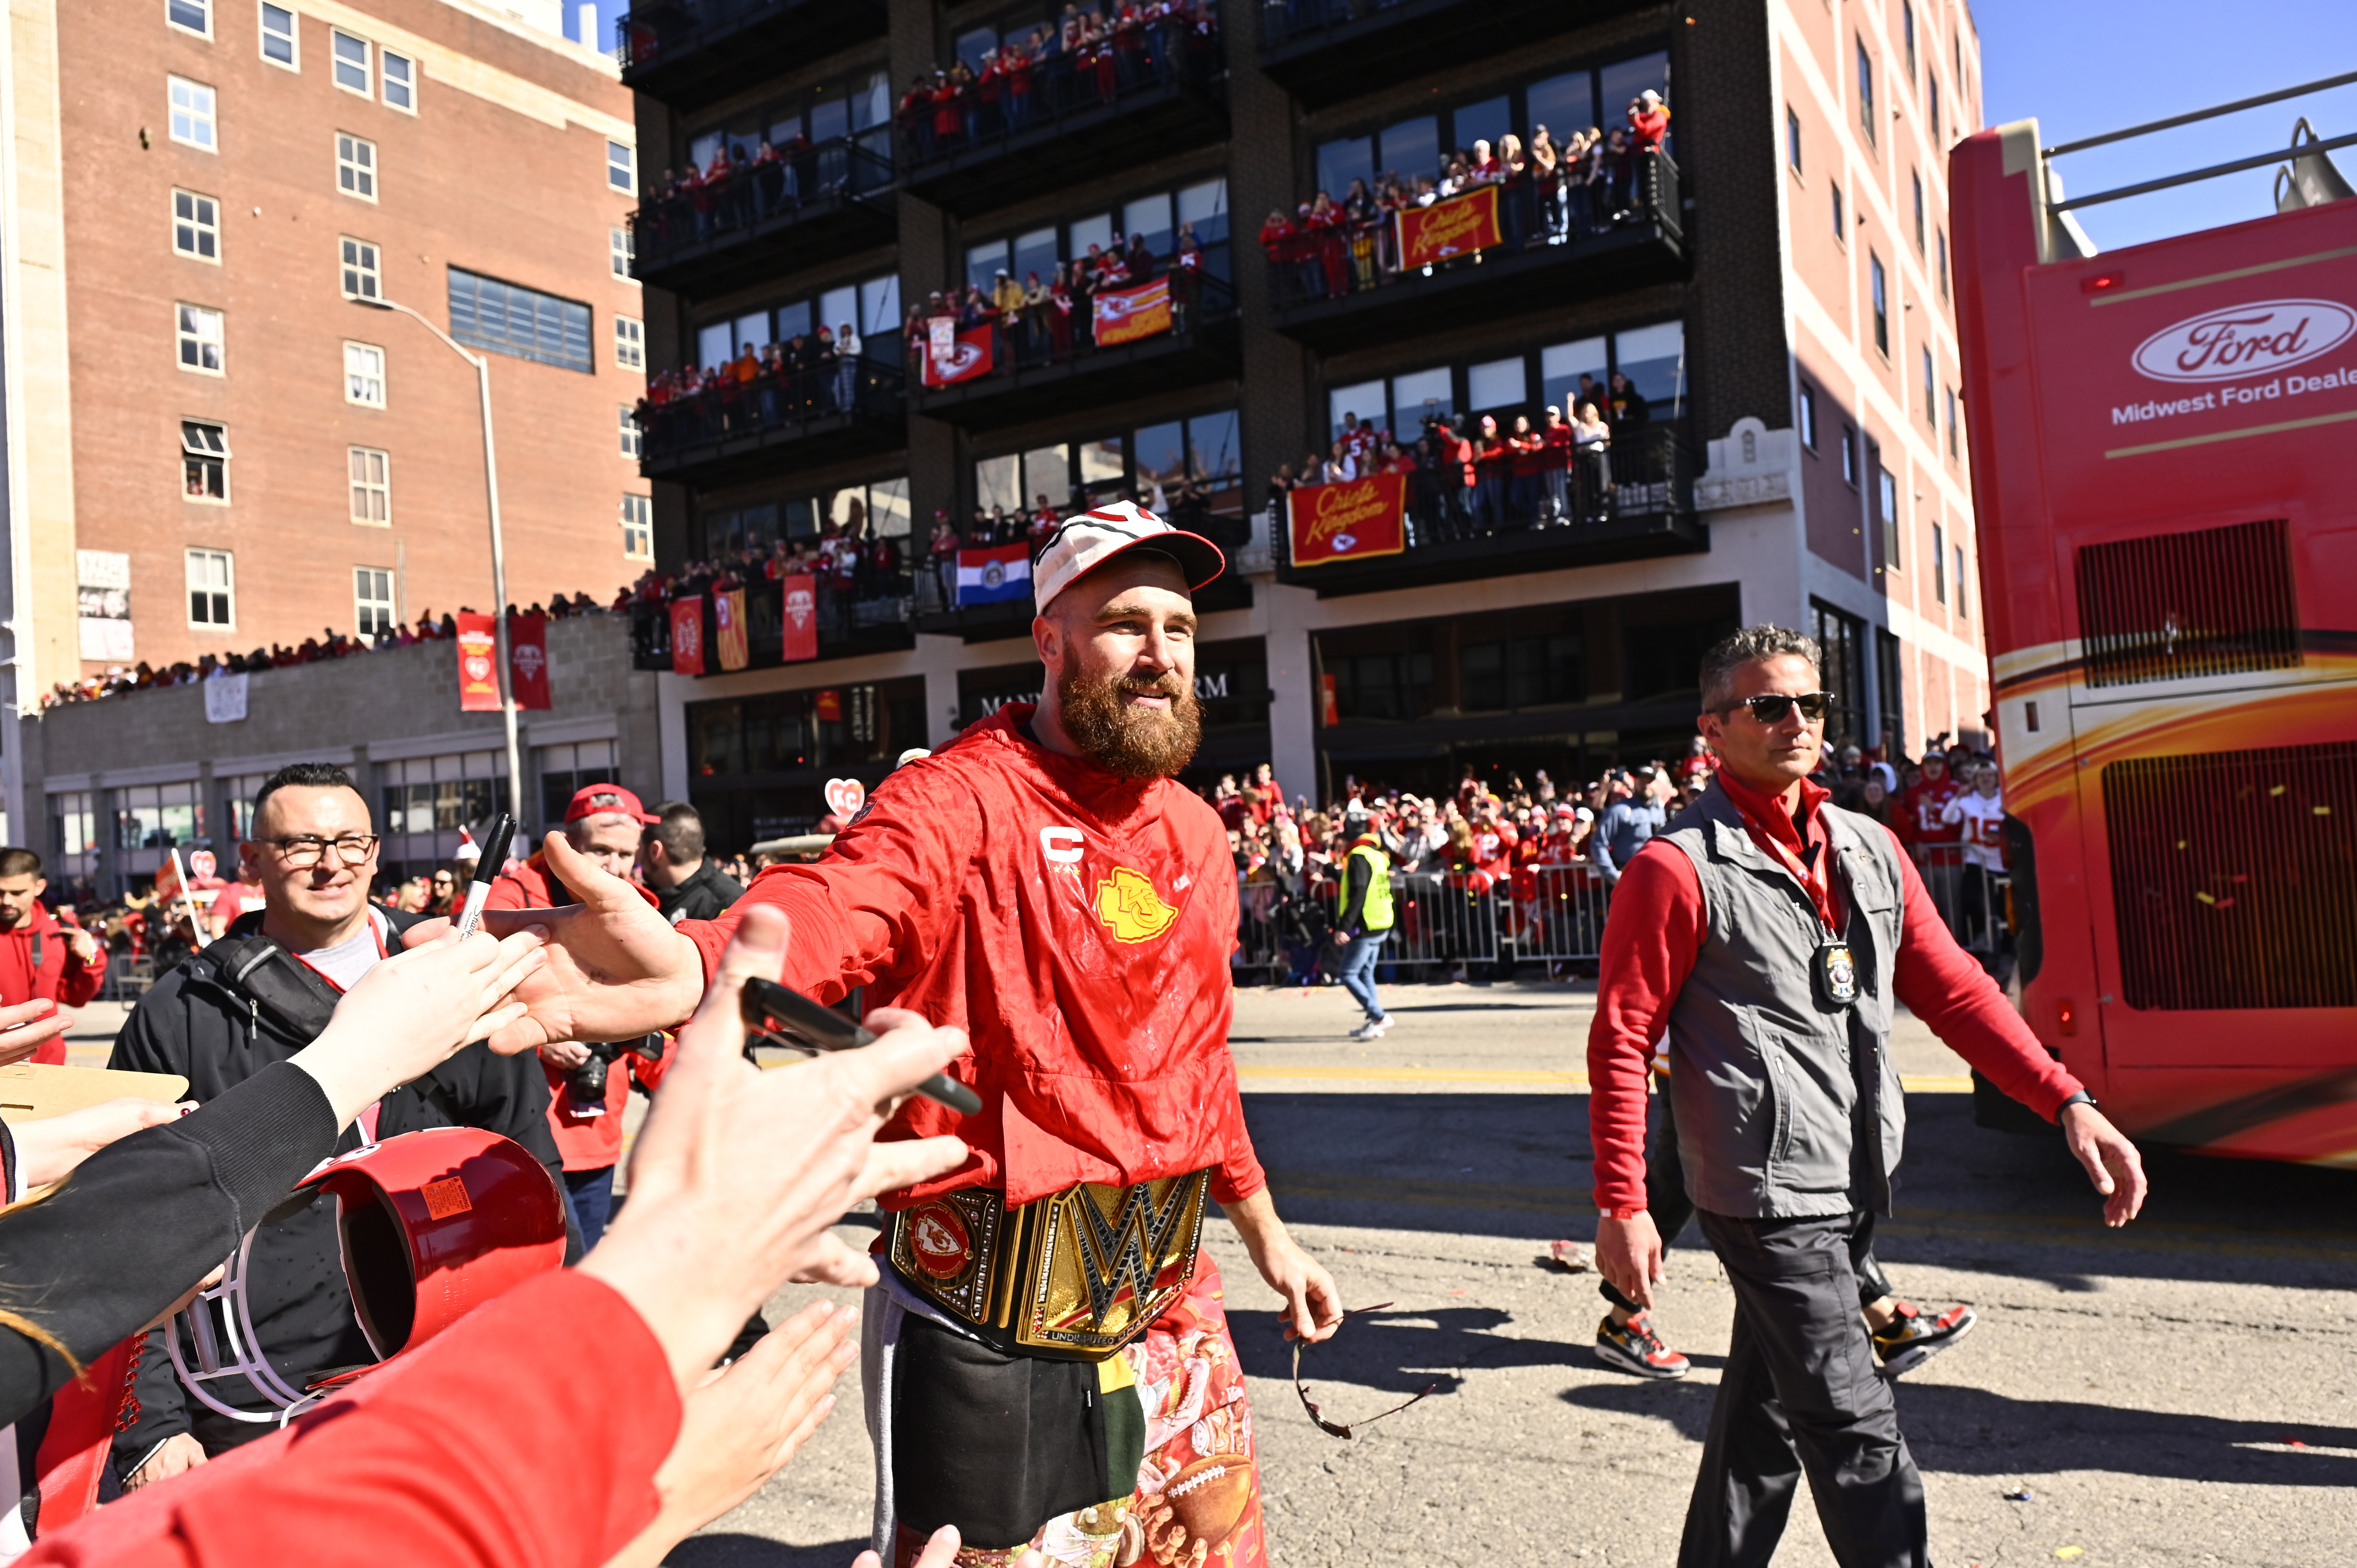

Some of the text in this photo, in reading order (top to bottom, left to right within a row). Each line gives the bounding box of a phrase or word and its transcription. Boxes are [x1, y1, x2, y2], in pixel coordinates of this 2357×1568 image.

[2178, 313, 2310, 371] Ford
[2111, 392, 2216, 426] Midwest
[2221, 378, 2281, 406] Ford
[832, 788, 857, 811] KC
[1040, 826, 1084, 863] C
[463, 905, 482, 939] Sharp
[1118, 885, 1160, 929] KC
[456, 1184, 470, 1210] WARNING:
[1052, 1331, 1115, 1345] UNDISPUTED
